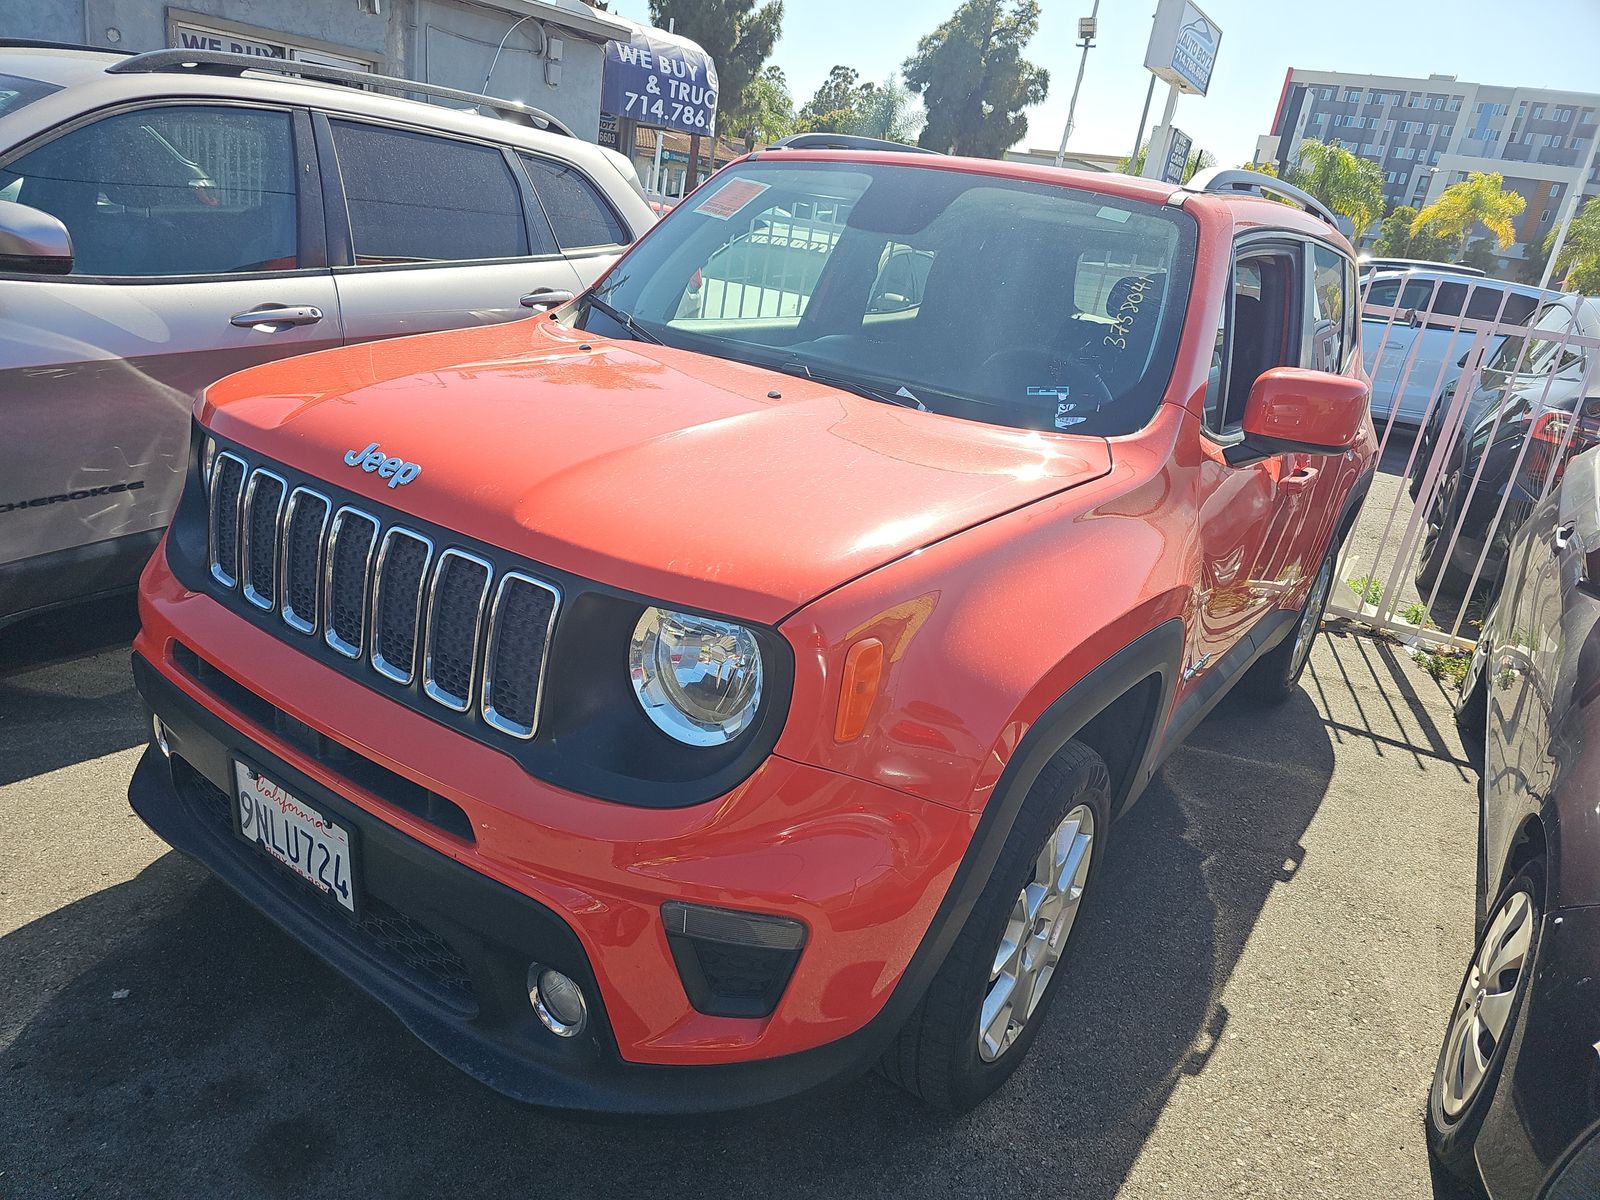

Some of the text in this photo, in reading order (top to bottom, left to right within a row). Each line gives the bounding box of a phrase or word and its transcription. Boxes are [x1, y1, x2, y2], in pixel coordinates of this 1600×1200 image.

[181, 33, 222, 51] WE
[616, 42, 653, 70] WE
[659, 55, 699, 82] BUY
[1180, 32, 1213, 70] AUTO BOYZ
[645, 75, 661, 96] &
[343, 442, 422, 489] Jeep
[255, 776, 333, 839] California
[240, 790, 349, 900] 9NLU724
